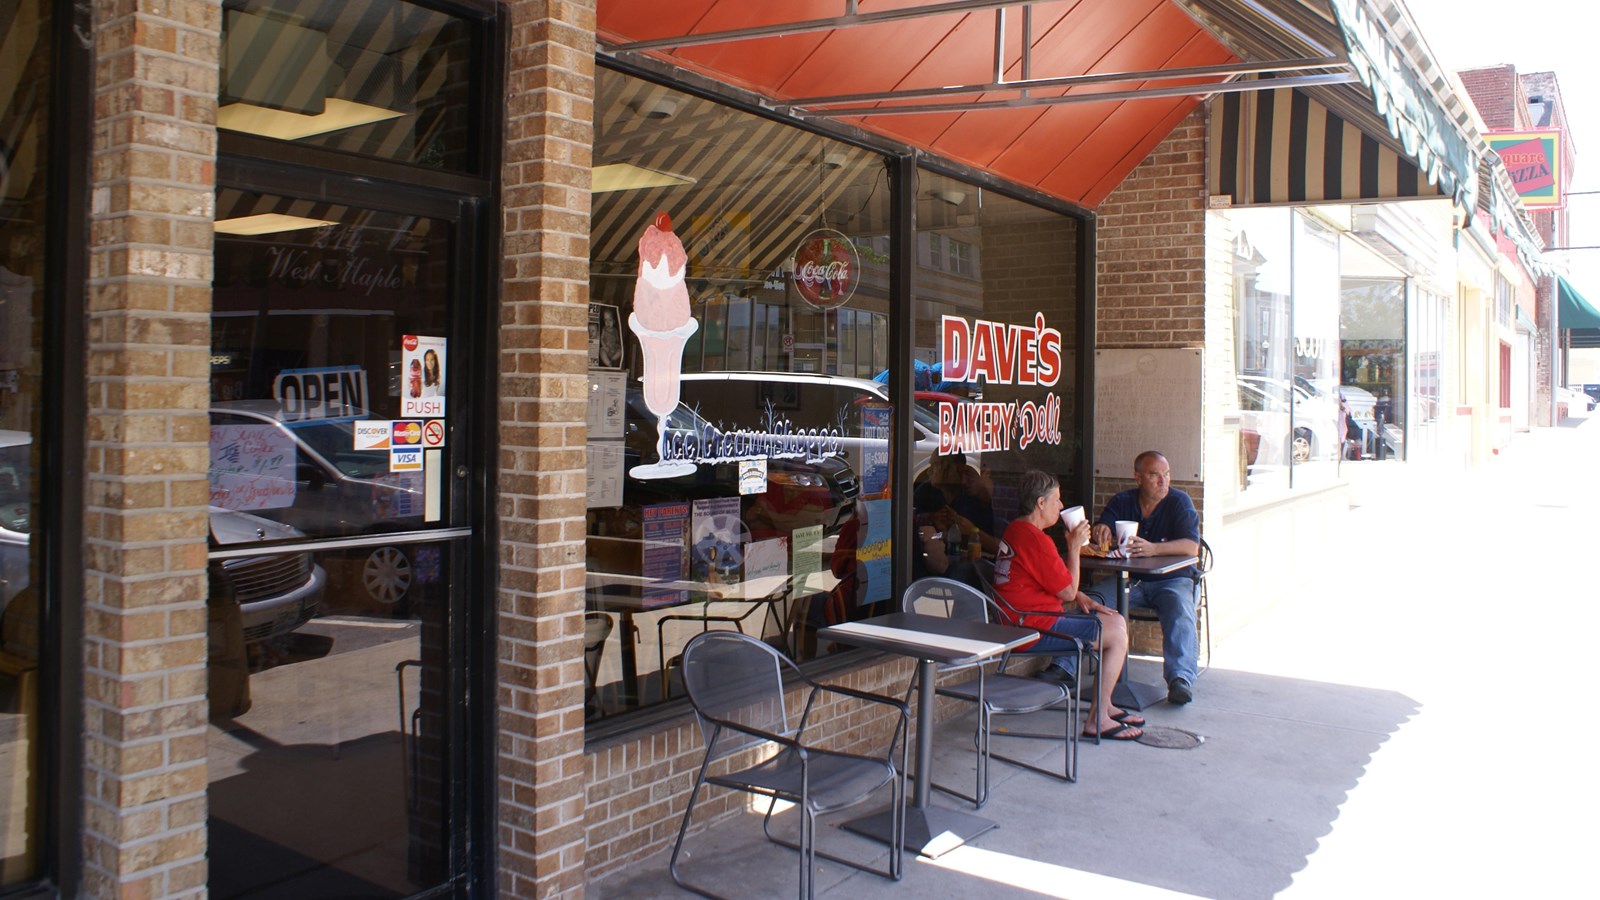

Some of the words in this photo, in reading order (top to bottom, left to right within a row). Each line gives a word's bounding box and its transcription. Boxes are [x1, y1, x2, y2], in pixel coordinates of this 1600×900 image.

[265, 246, 322, 281] West
[324, 257, 401, 296] Maple
[803, 260, 849, 284] Coca-Cola
[941, 311, 1061, 387] DAVE'S
[280, 371, 363, 422] OPEN
[406, 401, 441, 414] PUSH
[357, 427, 388, 435] DISCOVER
[662, 416, 696, 461] Ice
[702, 421, 769, 465] Cream
[769, 418, 839, 464] Shoppe
[877, 426, 889, 439] DOG
[938, 402, 1015, 456] BAKERY
[1020, 392, 1061, 450] Deli
[397, 454, 417, 463] VISA
